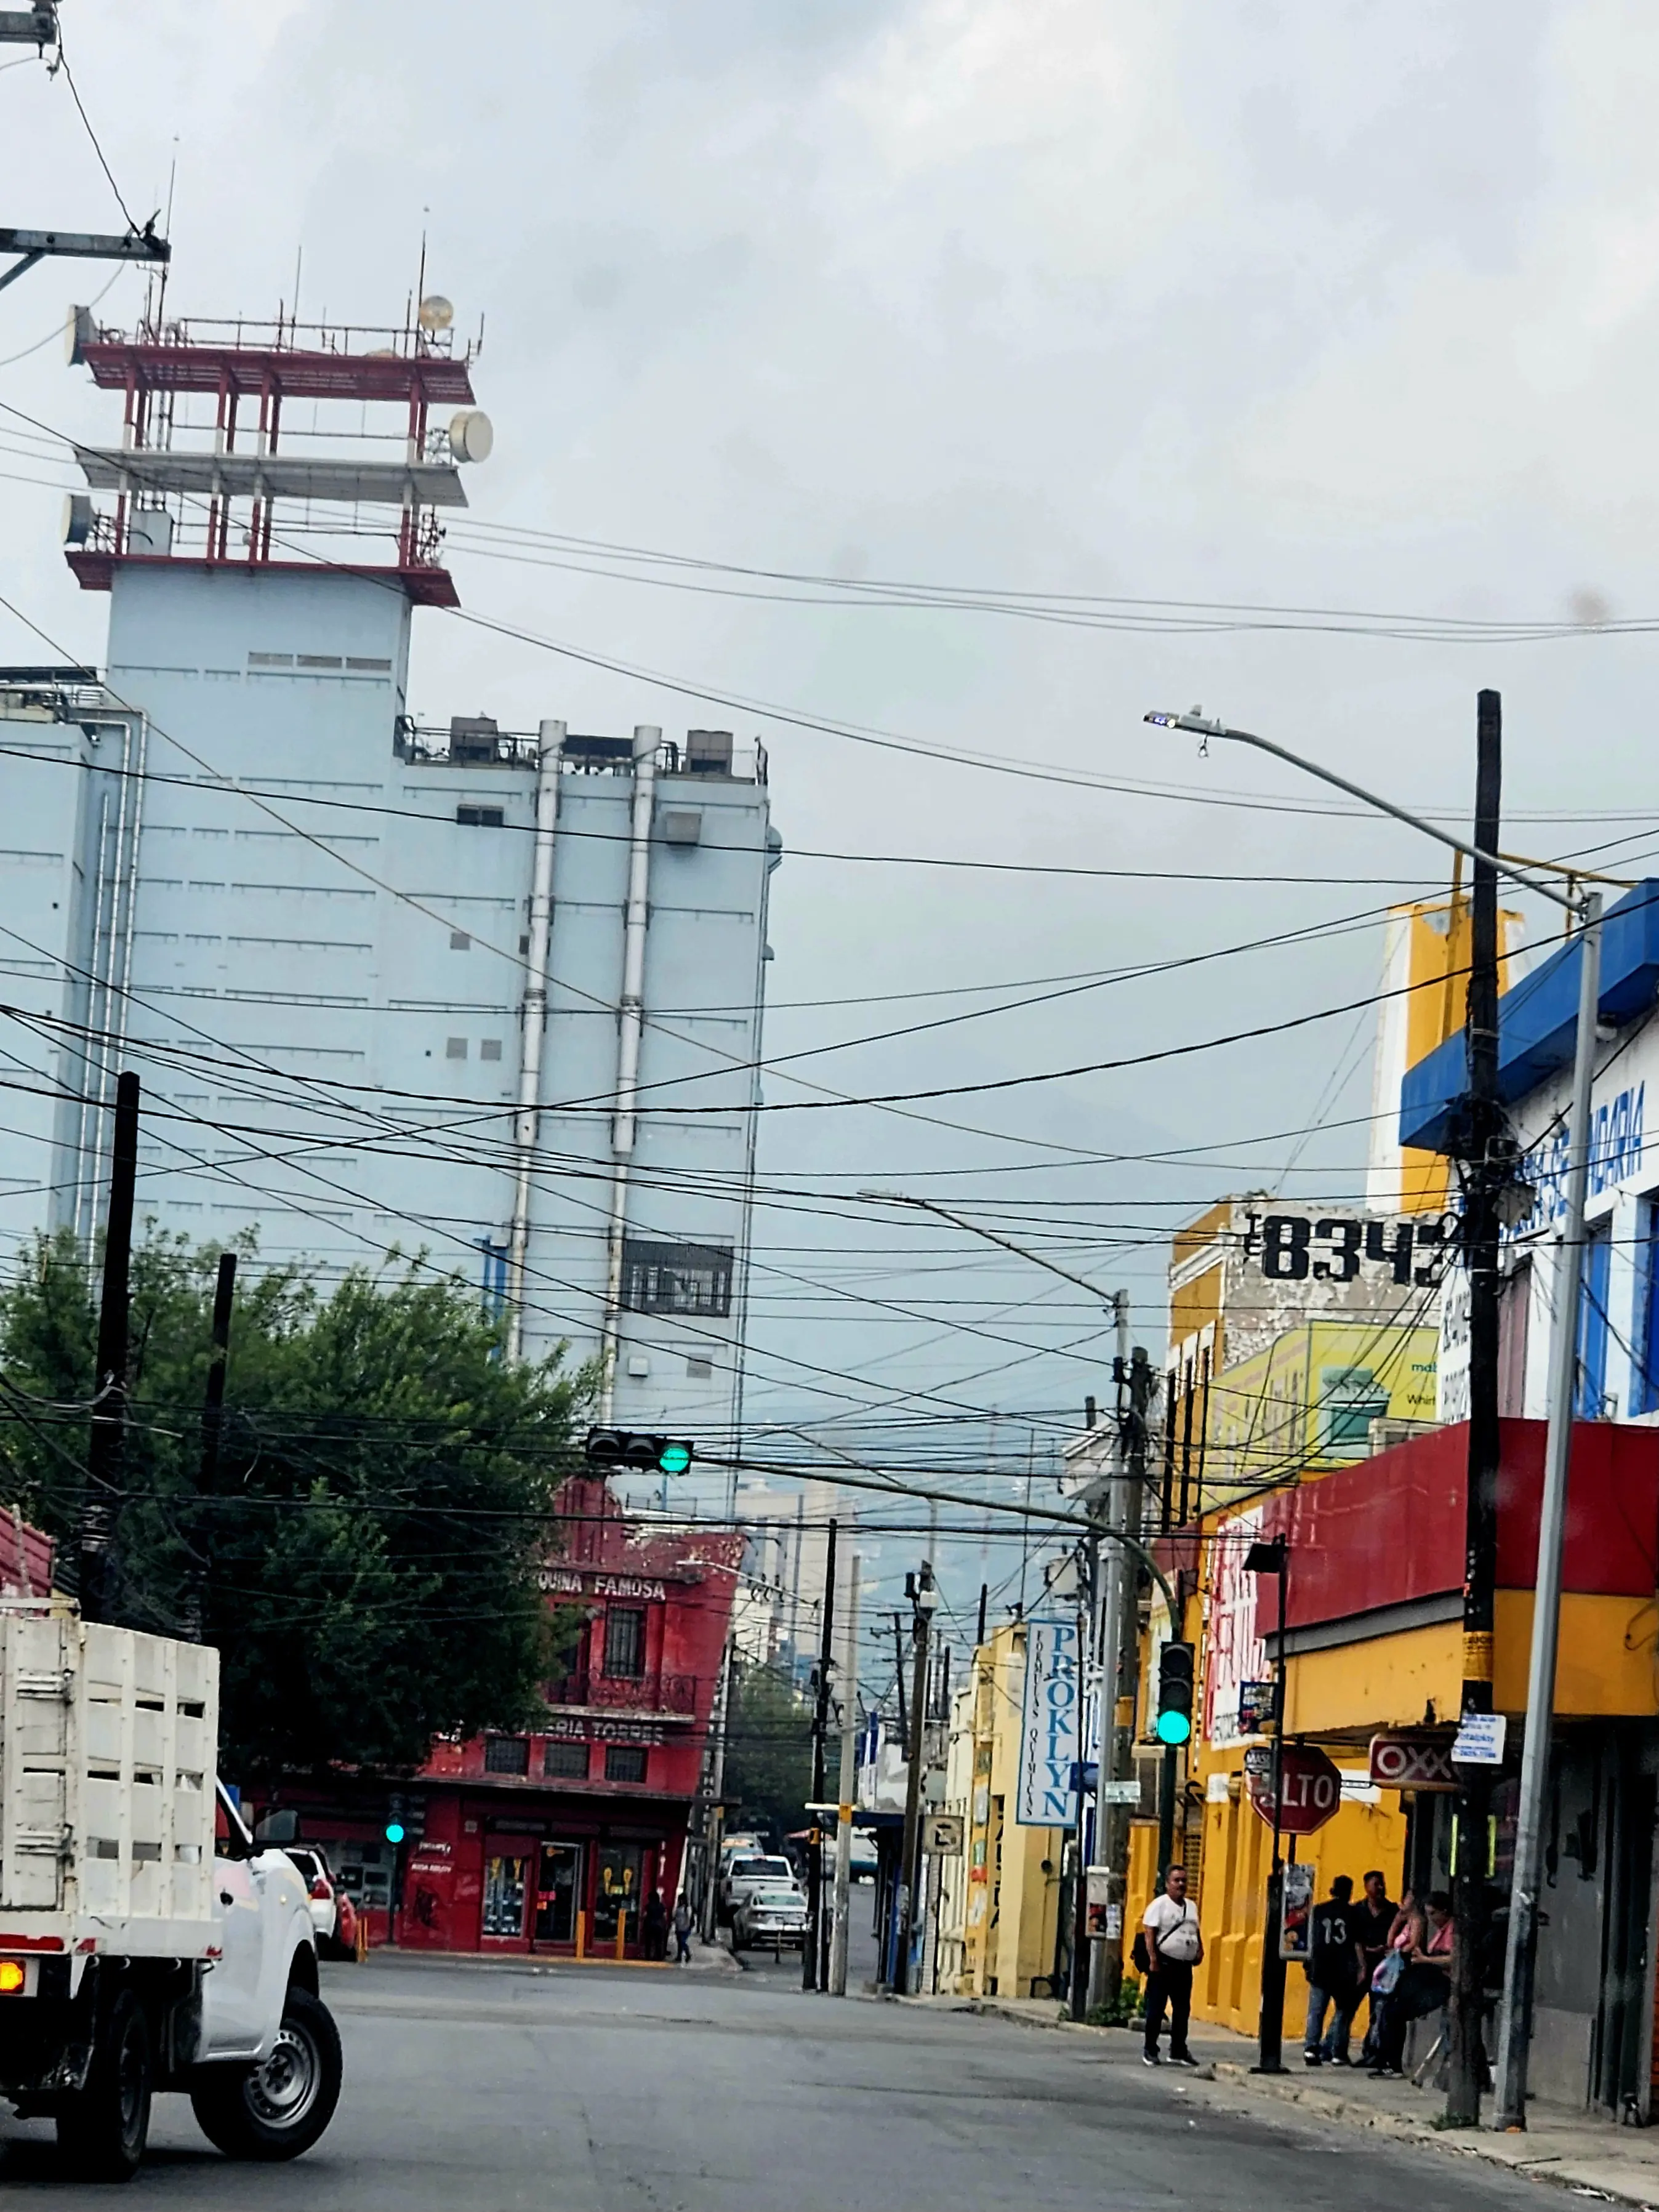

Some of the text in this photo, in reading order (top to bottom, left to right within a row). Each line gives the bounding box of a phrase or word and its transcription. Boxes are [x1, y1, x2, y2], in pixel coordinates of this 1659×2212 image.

[520, 1569, 666, 1601] QUINA FAMOSA
[1042, 1627, 1076, 1818] PROKLYN
[1376, 1745, 1461, 1782] OXX
[1262, 1772, 1334, 1808] LTO
[1322, 1917, 1347, 1945] 13
